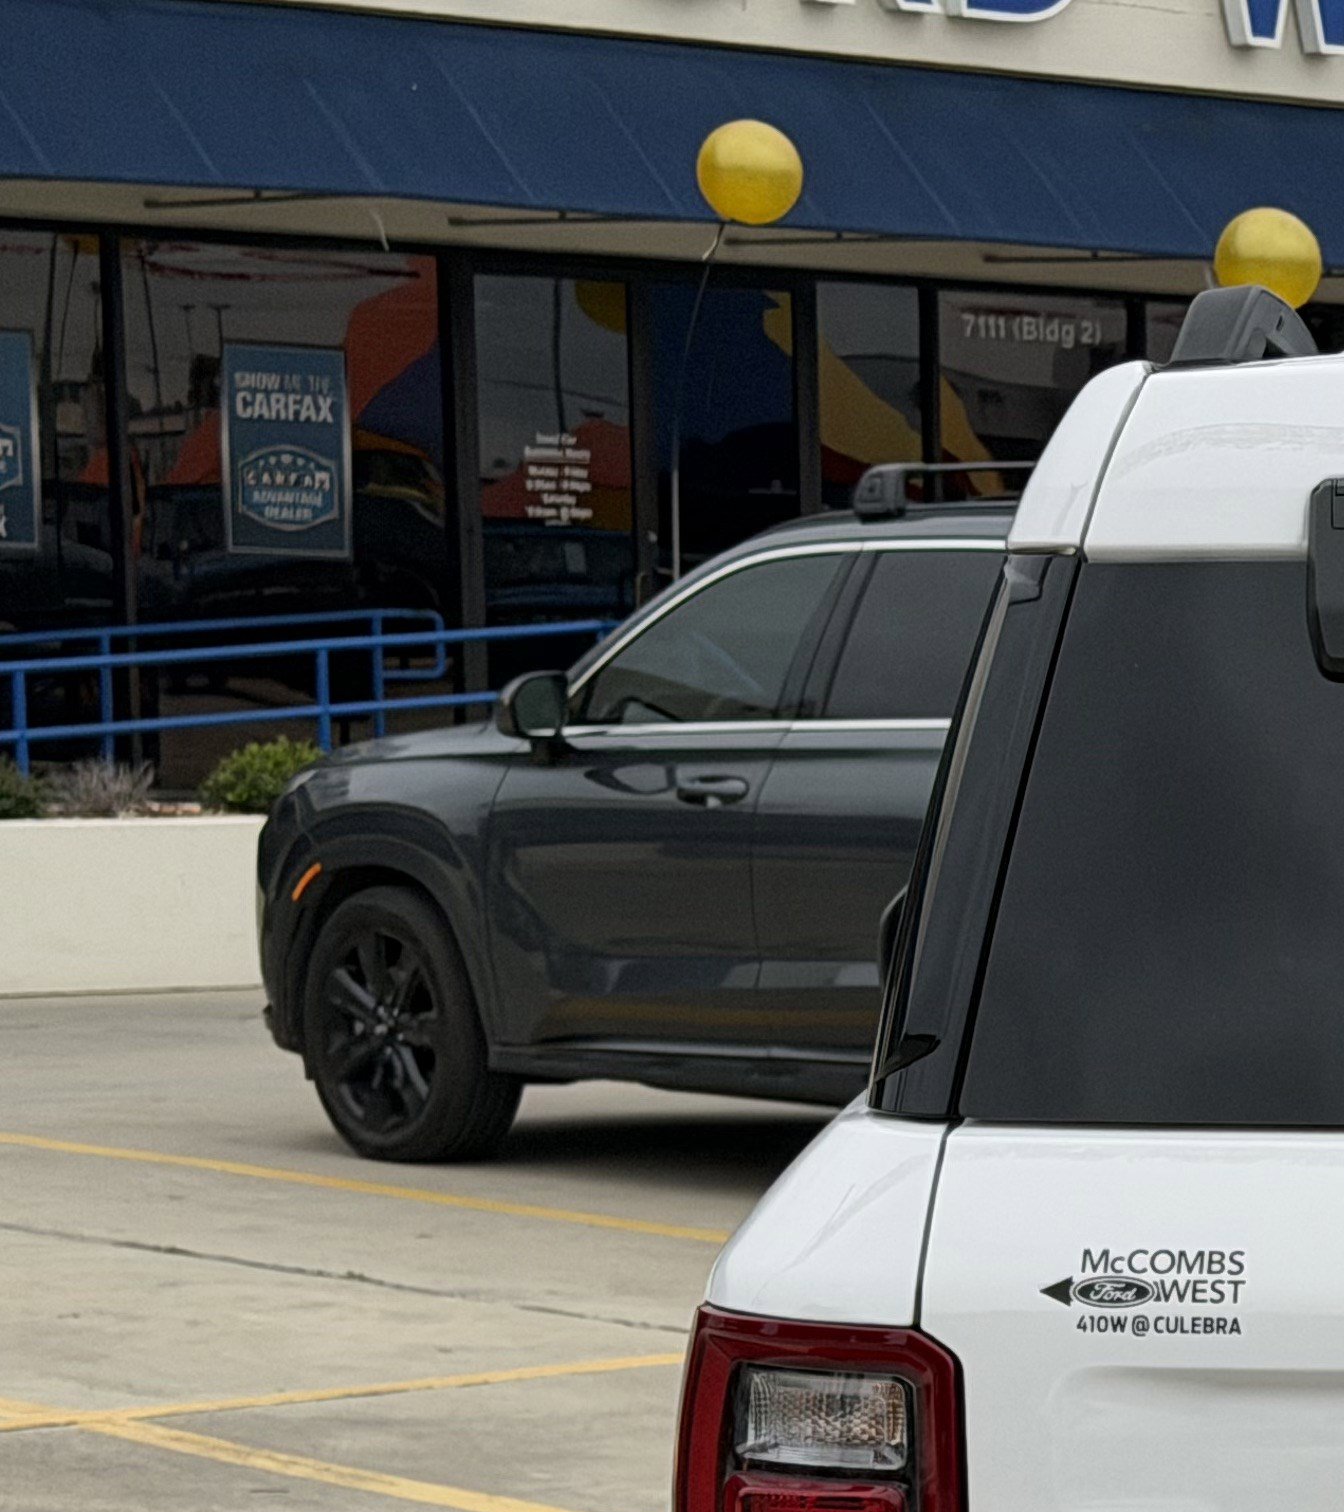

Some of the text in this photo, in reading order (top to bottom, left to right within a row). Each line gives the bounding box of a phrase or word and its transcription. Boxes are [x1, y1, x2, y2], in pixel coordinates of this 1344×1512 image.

[961, 313, 1006, 338] 7111
[1012, 316, 1076, 348] (Bldg
[235, 391, 333, 424] CARFAX
[1080, 1248, 1245, 1276] McCOMBS
[1158, 1279, 1246, 1305] WEST
[1153, 1315, 1242, 1335] CULEBRA
